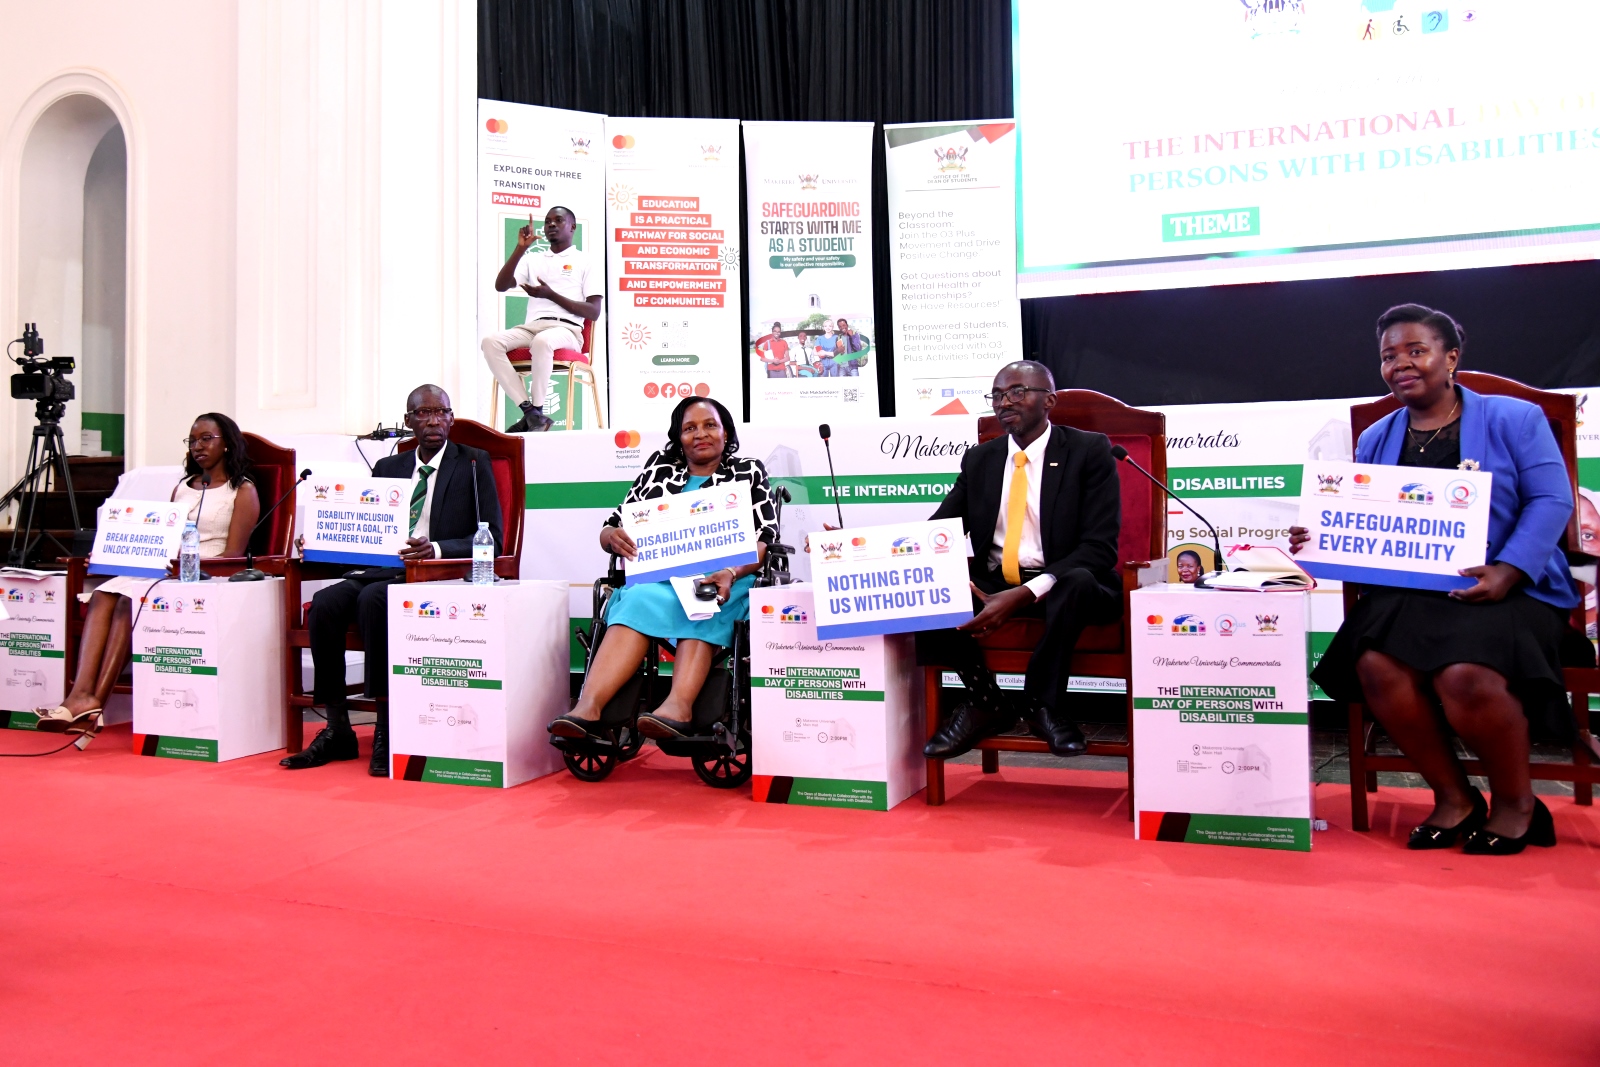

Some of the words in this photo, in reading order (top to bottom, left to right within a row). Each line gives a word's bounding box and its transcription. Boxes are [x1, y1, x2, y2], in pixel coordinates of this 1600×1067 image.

[1123, 136, 1184, 159] THE
[1193, 106, 1466, 154] INTERNATIONAL
[1129, 161, 1269, 192] PERSONS
[1278, 151, 1366, 179] WITH
[1377, 126, 1600, 170] DISABILITIES
[494, 164, 532, 175] EXPLORE
[535, 169, 552, 177] OUR
[555, 171, 582, 179] THREE
[494, 180, 545, 191] TRANSITION
[493, 194, 539, 206] PATHWAYS
[642, 200, 696, 209] EDUCATION
[762, 202, 859, 218] SAFEGUARDING
[899, 211, 935, 220] Beyond
[646, 216, 653, 224] A
[655, 216, 708, 225] PRACTICAL
[899, 221, 954, 229] Classroom:
[1170, 211, 1251, 237] THEME
[761, 221, 803, 235] STARTS
[807, 221, 838, 234] WITH
[842, 220, 861, 233] ME
[622, 230, 666, 239] PATHWAY
[668, 232, 687, 240] FOR
[689, 232, 724, 241] SOCIAL
[900, 231, 919, 239] Join
[922, 231, 937, 239] the
[769, 238, 783, 252] AS
[787, 238, 795, 252] A
[799, 237, 854, 252] STUDENT
[900, 241, 951, 250] Movement
[954, 239, 973, 247] and
[976, 239, 1000, 247] Drive
[638, 246, 658, 255] AND
[660, 247, 709, 255] ECONOMIC
[900, 251, 936, 260] Positive
[630, 261, 717, 271] TRANSFORMATION
[901, 272, 918, 280] Got
[921, 270, 969, 280] Questions
[972, 270, 1001, 278] about
[627, 280, 647, 288] AND
[649, 281, 722, 290] EMPOWERMENT
[902, 282, 934, 290] Mental
[938, 281, 969, 289] Health
[636, 296, 648, 305] OF
[650, 297, 719, 306] COMMUNITIES.
[902, 291, 972, 300] Relationships?
[921, 302, 944, 310] Have
[903, 322, 960, 332] Empowered
[964, 321, 1009, 329] Students,
[903, 334, 942, 342] Thriving
[944, 332, 989, 341] Campus:
[924, 342, 964, 351] Involved
[966, 341, 986, 349] with
[904, 354, 923, 362] Plus
[926, 353, 968, 361] Activities
[1166, 430, 1241, 449] morates
[823, 485, 850, 497] THE
[854, 483, 955, 497] INTERNATION
[1173, 476, 1285, 491] DISABILITIES
[318, 510, 355, 520] DISABILITY
[357, 512, 394, 523] INCLUSION
[325, 522, 338, 530] NOT
[339, 523, 355, 532] JUST
[363, 525, 383, 534] GOAL,
[1321, 509, 1466, 539] SAFEGUARDING
[106, 532, 128, 542] BREAK
[130, 534, 164, 545] BARRIERS
[637, 527, 696, 548] DISABILITY
[699, 519, 739, 535] RIGHTS
[1189, 526, 1232, 538] Social
[1238, 528, 1289, 540] Progre
[316, 533, 321, 541] A
[323, 533, 359, 543] MAKERERE
[361, 536, 383, 545] VALUE
[103, 545, 129, 555] UNLOCK
[131, 547, 168, 558] POTENTIAL
[637, 549, 659, 562] ARE
[661, 541, 702, 558] HUMAN
[705, 532, 745, 548] RIGHTS
[1319, 533, 1378, 555] EVERY
[1381, 539, 1455, 562] ABILITY
[828, 570, 900, 592] NOTHING
[904, 567, 934, 585] FOR
[830, 597, 850, 615] US
[854, 590, 925, 612] WITHOUT
[929, 587, 951, 605] US
[408, 657, 422, 665] THE
[423, 658, 481, 668] INTERNATIONAL
[1152, 656, 1189, 667] Makerere
[1190, 656, 1228, 669] University
[1229, 657, 1281, 667] Commemorates
[432, 668, 467, 677] PERSONS
[468, 670, 487, 678] WITH
[769, 667, 785, 675] THE
[787, 668, 859, 677] INTERNATIONAL
[422, 678, 469, 687] DISABILITIES
[764, 678, 782, 687] DAY
[784, 679, 796, 687] OF
[798, 680, 841, 688] PERSONS
[843, 681, 866, 689] WITH
[787, 691, 843, 699] DISABILITIES
[1158, 687, 1179, 695] THE
[1182, 687, 1274, 697] INTERNATIONAL
[1152, 699, 1175, 709] DAY
[1177, 700, 1192, 709] OF
[1195, 700, 1251, 709] PERSONS
[1254, 701, 1283, 710] WITH
[1181, 712, 1255, 723] DISABILITIES
